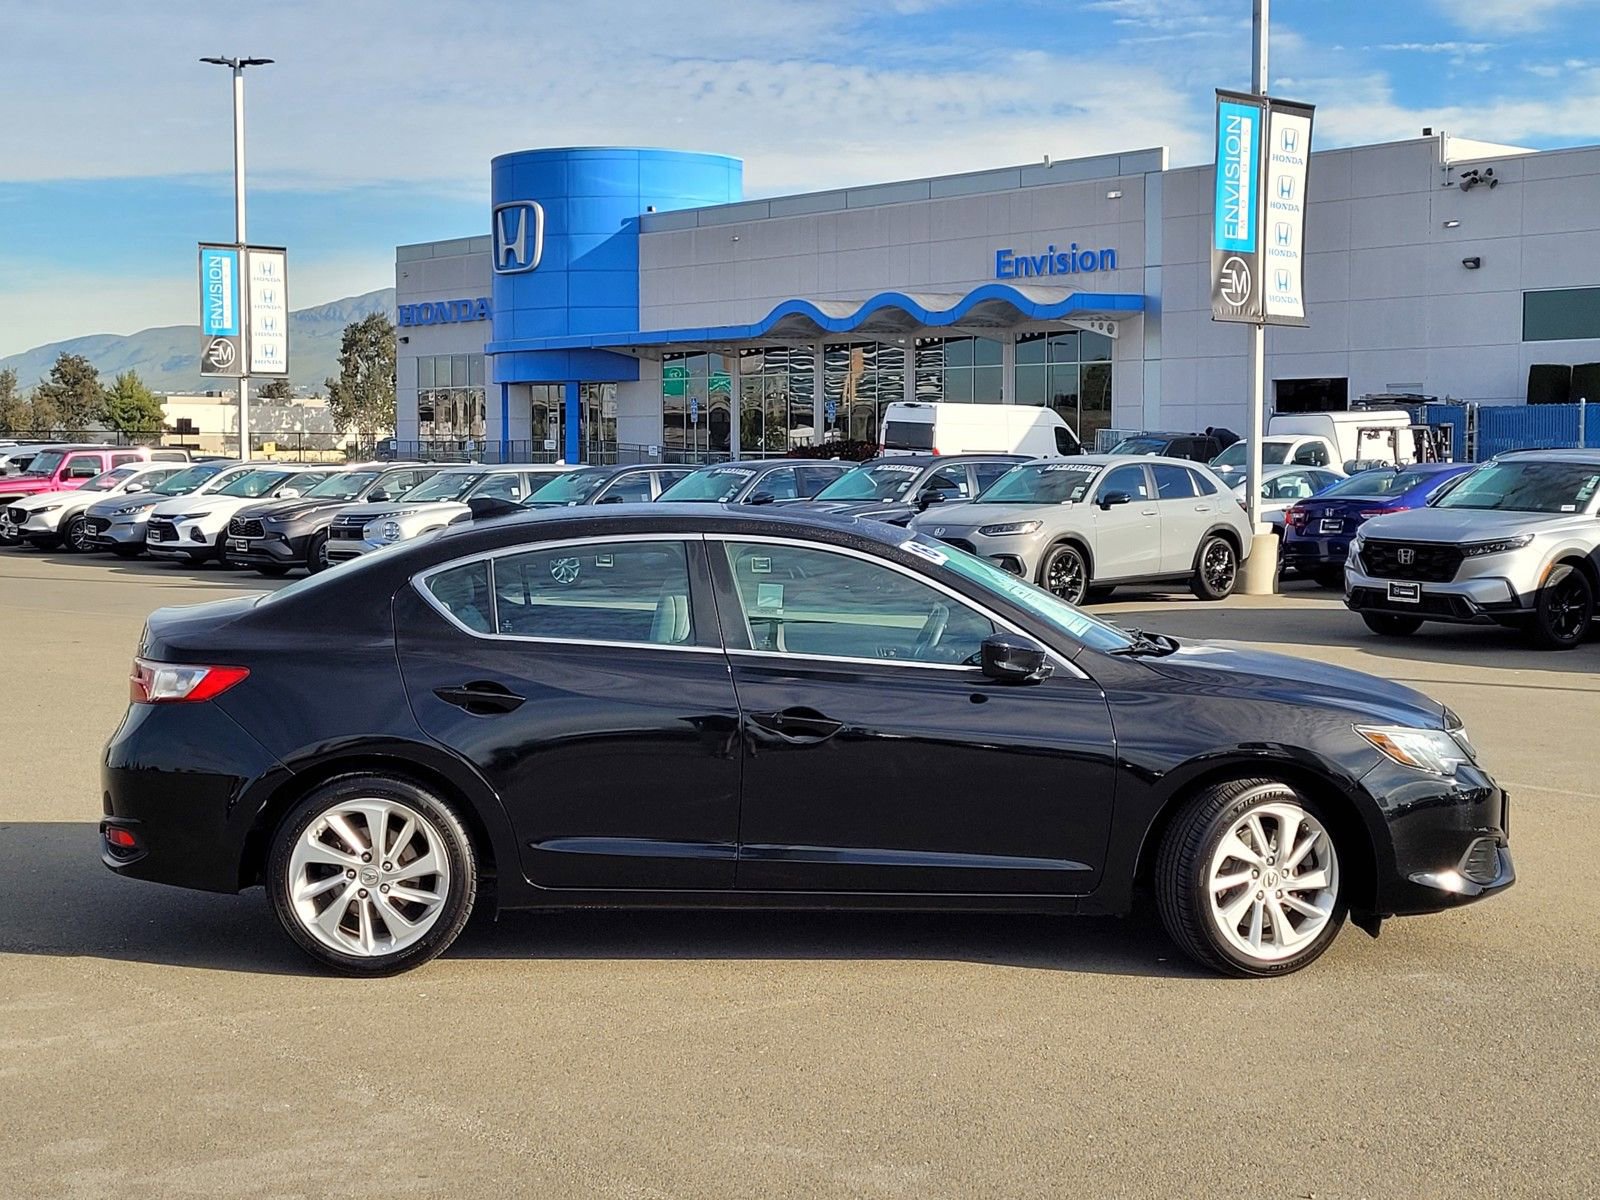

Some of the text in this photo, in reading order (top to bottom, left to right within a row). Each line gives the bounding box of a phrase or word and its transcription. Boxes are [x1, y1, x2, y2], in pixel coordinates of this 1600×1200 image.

[1271, 153, 1303, 166] HONDA
[1224, 115, 1241, 239] ENVISION
[1270, 201, 1299, 212] HONDA
[996, 242, 1117, 279] Envision
[1268, 248, 1298, 258] HONDA
[211, 255, 223, 329] ENVISION
[1268, 295, 1299, 304] HONDA
[397, 297, 493, 327] HONDA
[1236, 790, 1284, 813] MICHELIN
